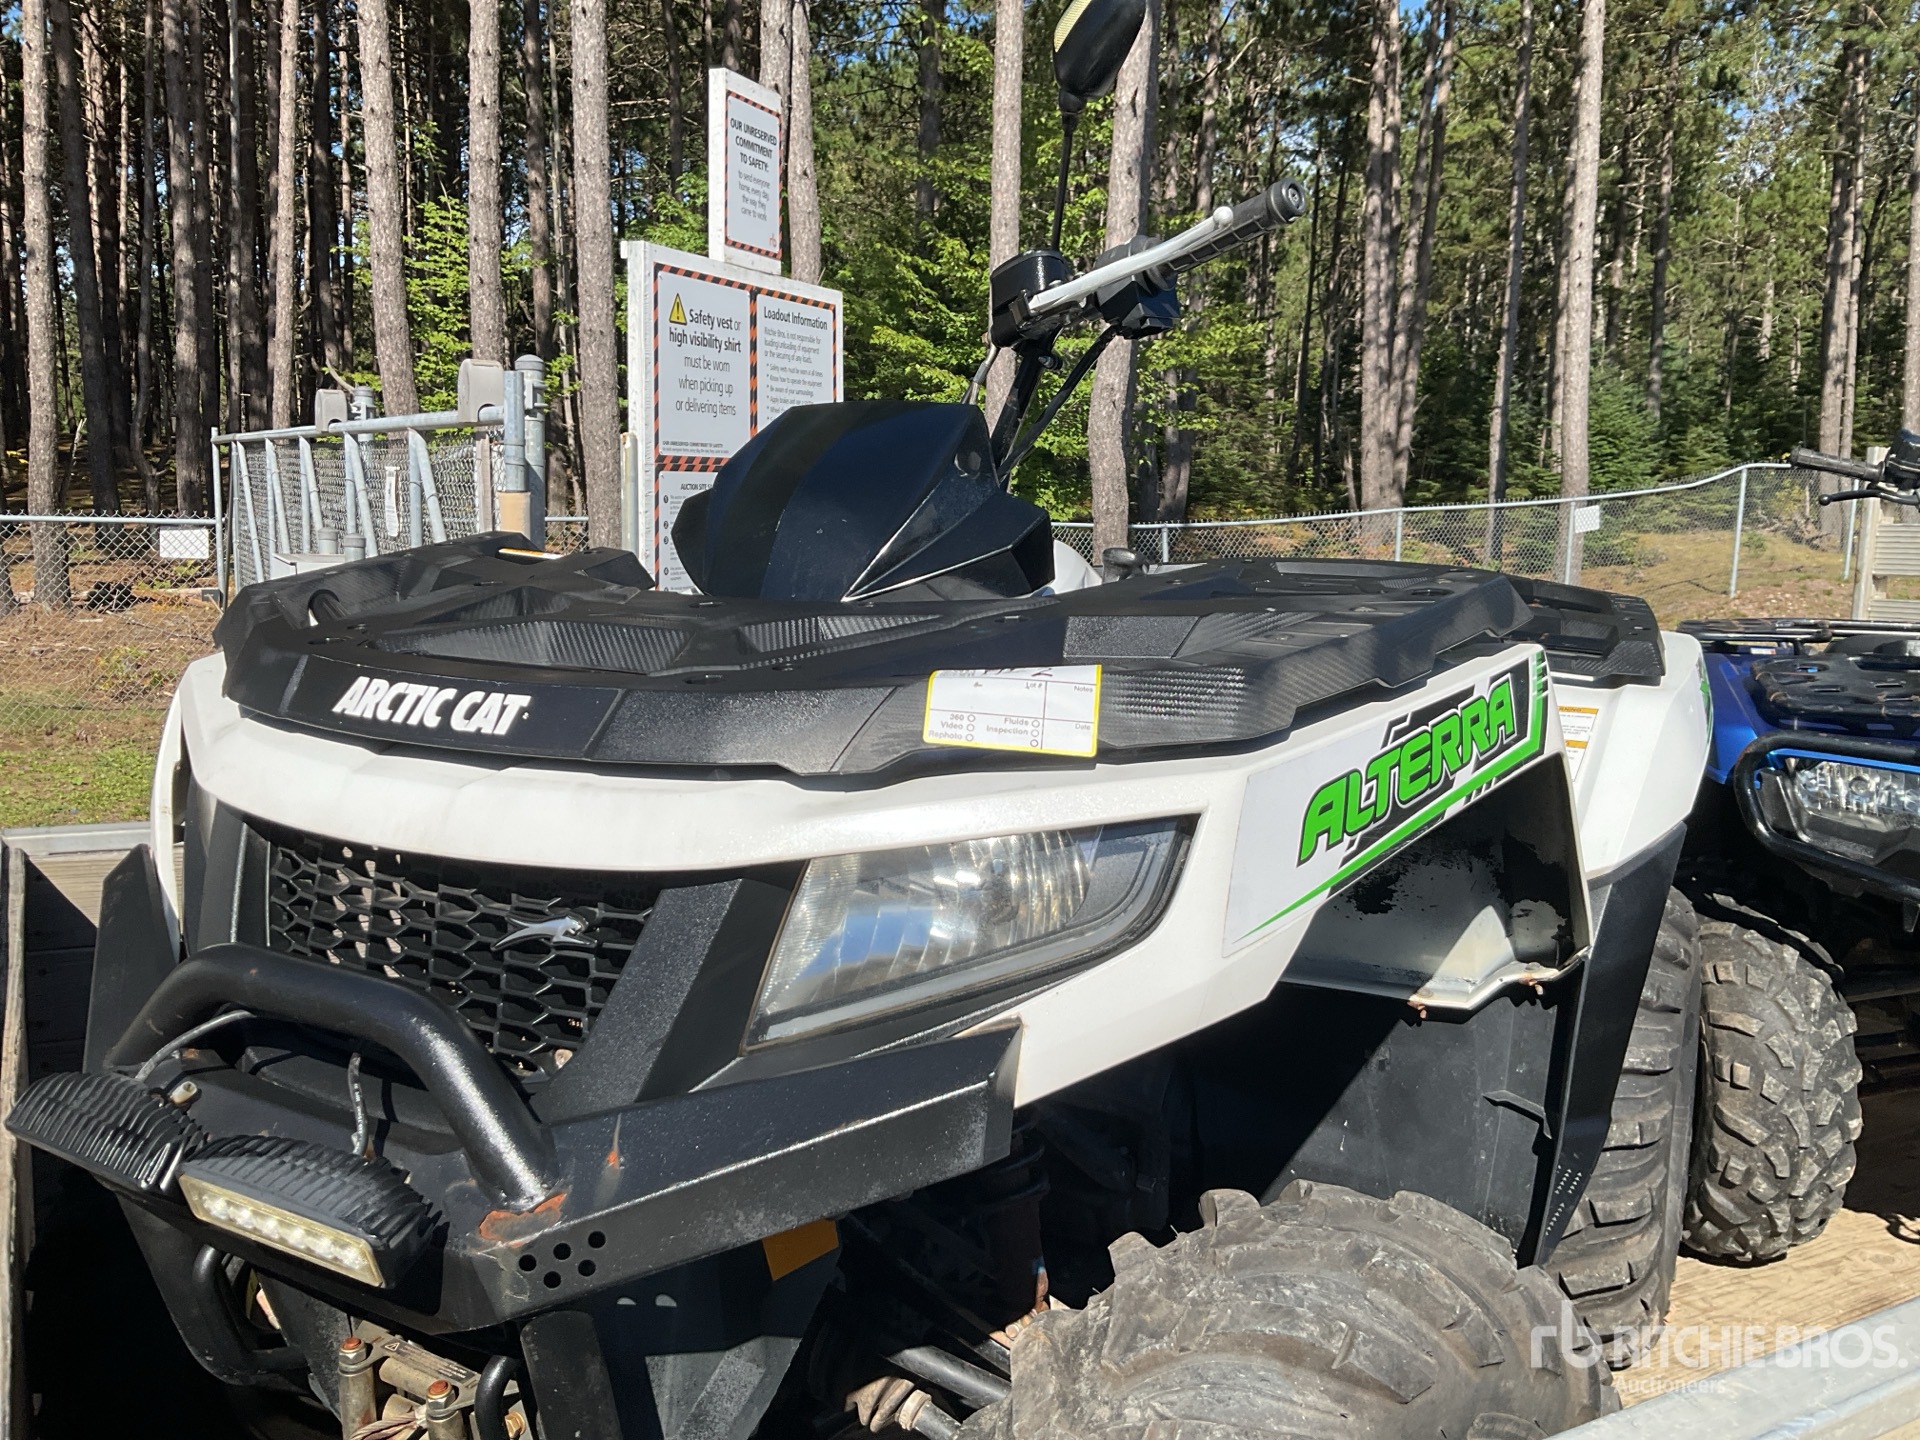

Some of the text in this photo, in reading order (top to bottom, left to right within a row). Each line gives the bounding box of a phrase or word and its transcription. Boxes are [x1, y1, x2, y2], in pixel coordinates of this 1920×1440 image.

[730, 118, 777, 146] OUR UNRESERVED
[735, 135, 773, 159] COMMITMENT
[740, 152, 748, 164] TO
[689, 308, 741, 331] Safety vest or
[764, 306, 828, 330] Loadout Information
[669, 327, 741, 353] high visibility shirt
[684, 355, 730, 372] must be worn
[679, 374, 734, 397] when picking up
[675, 397, 736, 418] or delivering items
[1073, 685, 1094, 693] Notes
[332, 675, 532, 736] ARCTIC CAT
[940, 720, 964, 730] Video
[950, 713, 965, 721] 360
[1004, 717, 1029, 726] Fluids
[928, 730, 963, 740] Rephoto
[986, 725, 1029, 735] Inspection
[1075, 723, 1091, 731] Date
[1297, 674, 1516, 867] ALTERRA
